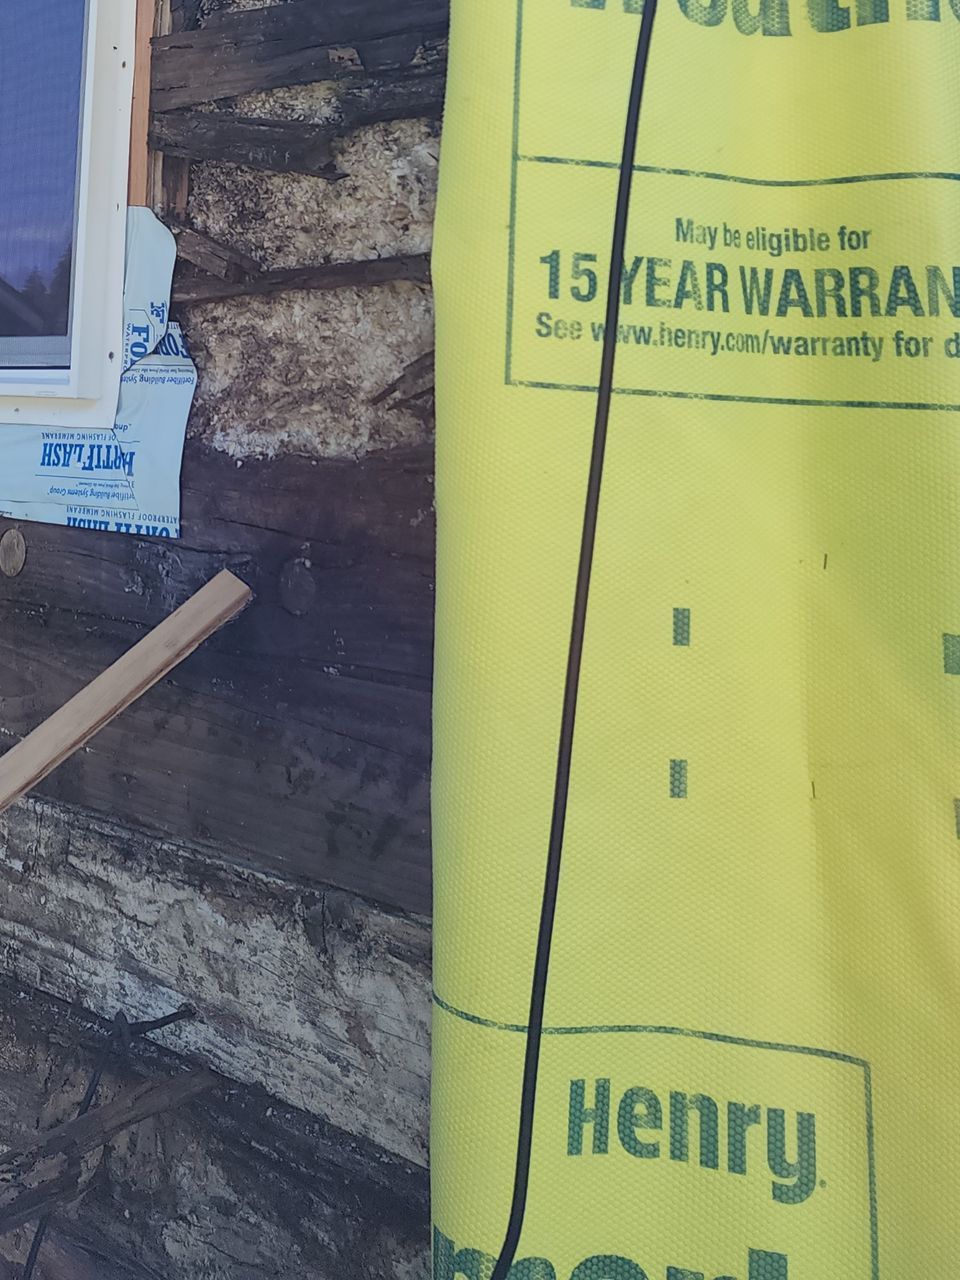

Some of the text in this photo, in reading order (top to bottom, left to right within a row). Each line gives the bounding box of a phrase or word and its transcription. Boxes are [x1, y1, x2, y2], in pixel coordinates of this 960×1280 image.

[675, 218, 871, 257] May be eligible for
[539, 249, 960, 318] 15 YEAR WARRAN
[130, 324, 150, 365] FO
[535, 311, 582, 340] See
[590, 321, 883, 362] www.henry.com/warranty
[892, 330, 933, 358] for
[41, 432, 75, 440] MEMBRANE
[77, 433, 107, 441] FLASHING
[66, 505, 99, 517] MEMBRAN
[101, 510, 135, 520] FLASHING
[567, 1078, 817, 1205] Henry
